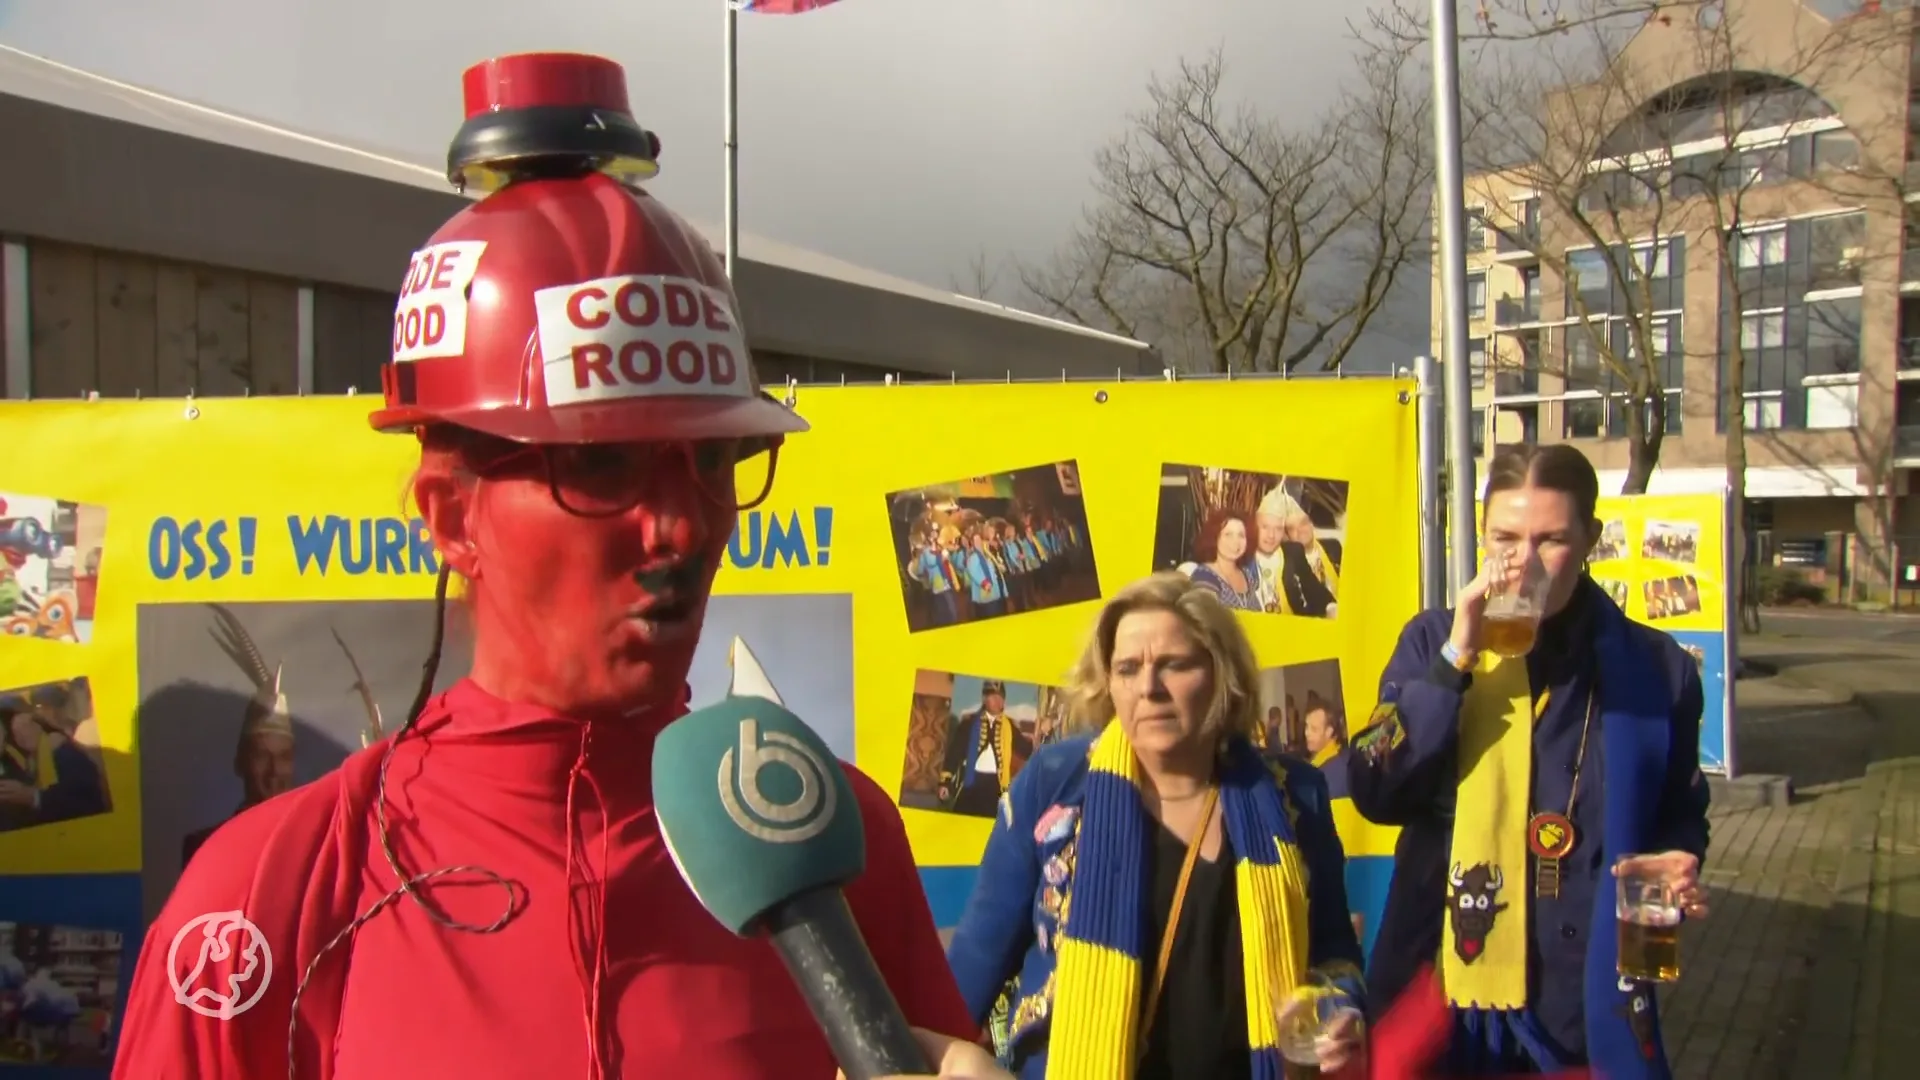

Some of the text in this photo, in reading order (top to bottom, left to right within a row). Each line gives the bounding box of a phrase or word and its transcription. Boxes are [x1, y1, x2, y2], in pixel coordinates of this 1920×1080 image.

[402, 249, 461, 299] ODE
[395, 303, 446, 353] OOD
[567, 282, 731, 332] CODE
[572, 340, 737, 389] ROOD
[148, 506, 833, 581] OSS! WURR UM!
